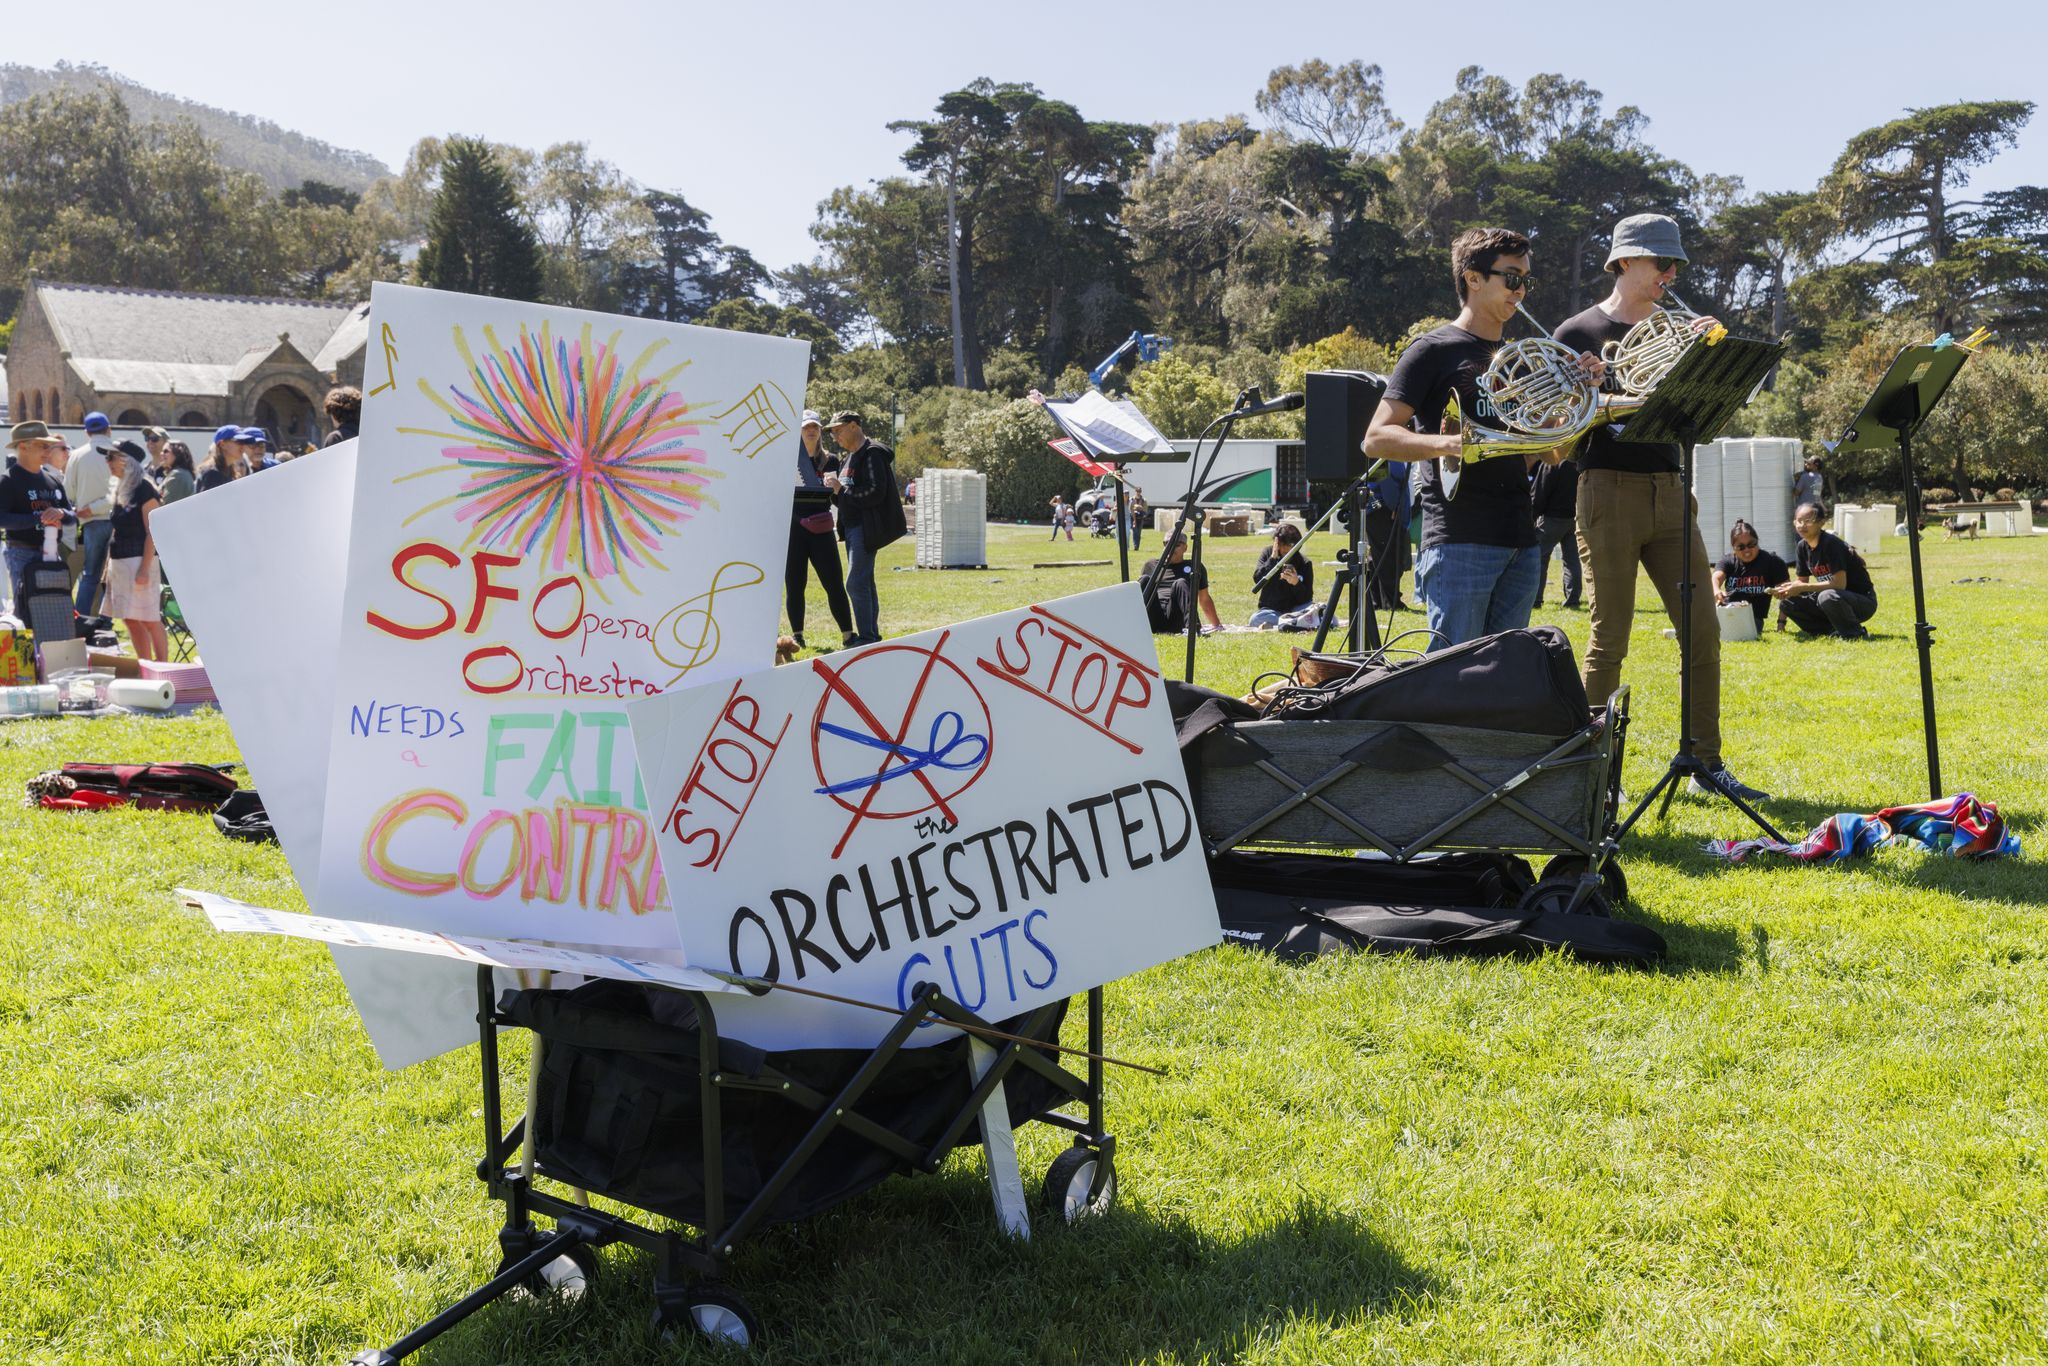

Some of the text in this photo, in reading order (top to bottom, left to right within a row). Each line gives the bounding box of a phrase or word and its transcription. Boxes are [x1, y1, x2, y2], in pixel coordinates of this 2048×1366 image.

[350, 700, 465, 739] NEEDS
[462, 646, 664, 698] Orchestra
[996, 617, 1152, 730] STOP
[401, 750, 428, 768] a
[673, 695, 777, 868] STOP
[360, 789, 673, 916] CONTR
[914, 816, 958, 840] the
[729, 780, 1192, 997] ORCHESTRATED
[897, 909, 1059, 1028] CUTS
